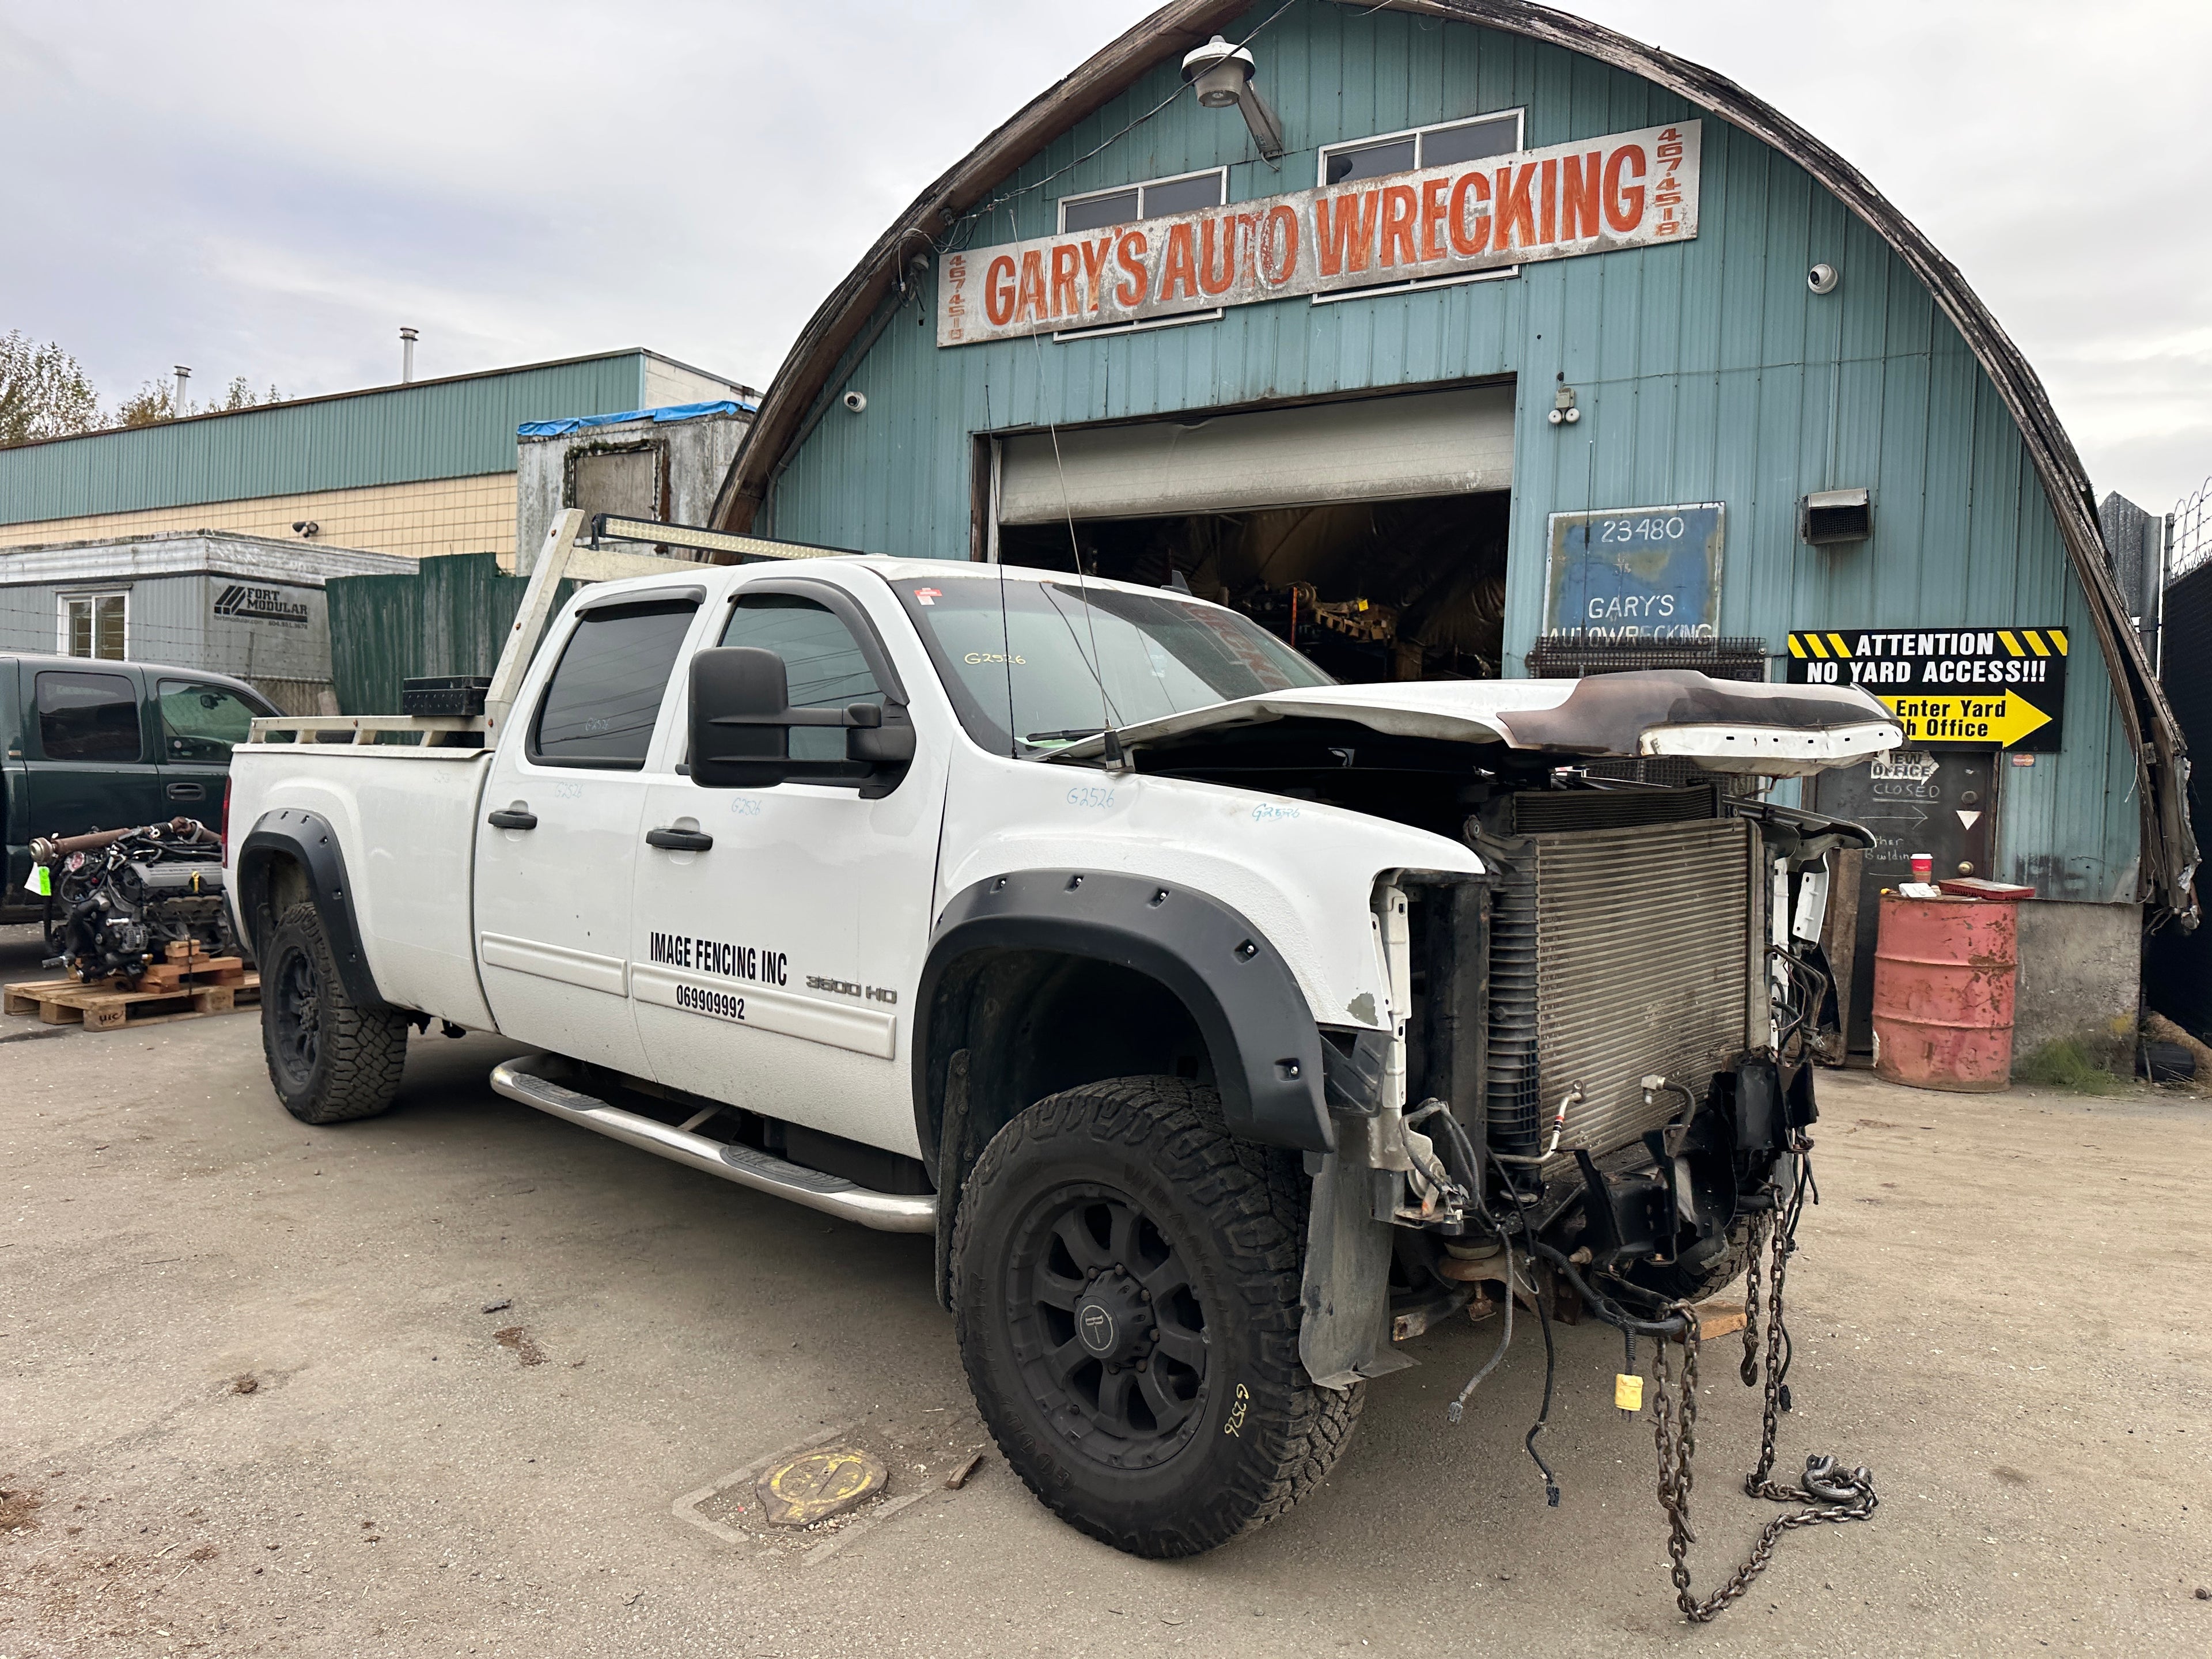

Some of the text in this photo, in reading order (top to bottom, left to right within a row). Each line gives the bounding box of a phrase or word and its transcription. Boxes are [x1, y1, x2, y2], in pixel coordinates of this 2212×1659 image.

[984, 144, 1646, 326] GARY'S AUTO WRECKING
[1601, 517, 1684, 543] 23480
[247, 588, 279, 601] FORT
[247, 599, 308, 615] MODULAR
[1589, 594, 1674, 619] GARY'S
[1855, 632, 1994, 657] ATTENTION
[964, 652, 1027, 665] G2526
[1807, 660, 2046, 683] NO YARD ACCESS!!!
[1896, 699, 2006, 718] Enter Yard
[1927, 718, 1988, 737] Office
[1067, 787, 1114, 808] G2526
[1873, 783, 1940, 798] CLOSED
[732, 797, 762, 816] G2526
[650, 931, 787, 986] IMAGE FENCING INC
[806, 975, 897, 1004] 3500 HD
[676, 984, 745, 1020] 069909992
[1224, 1384, 1249, 1438] G2526
